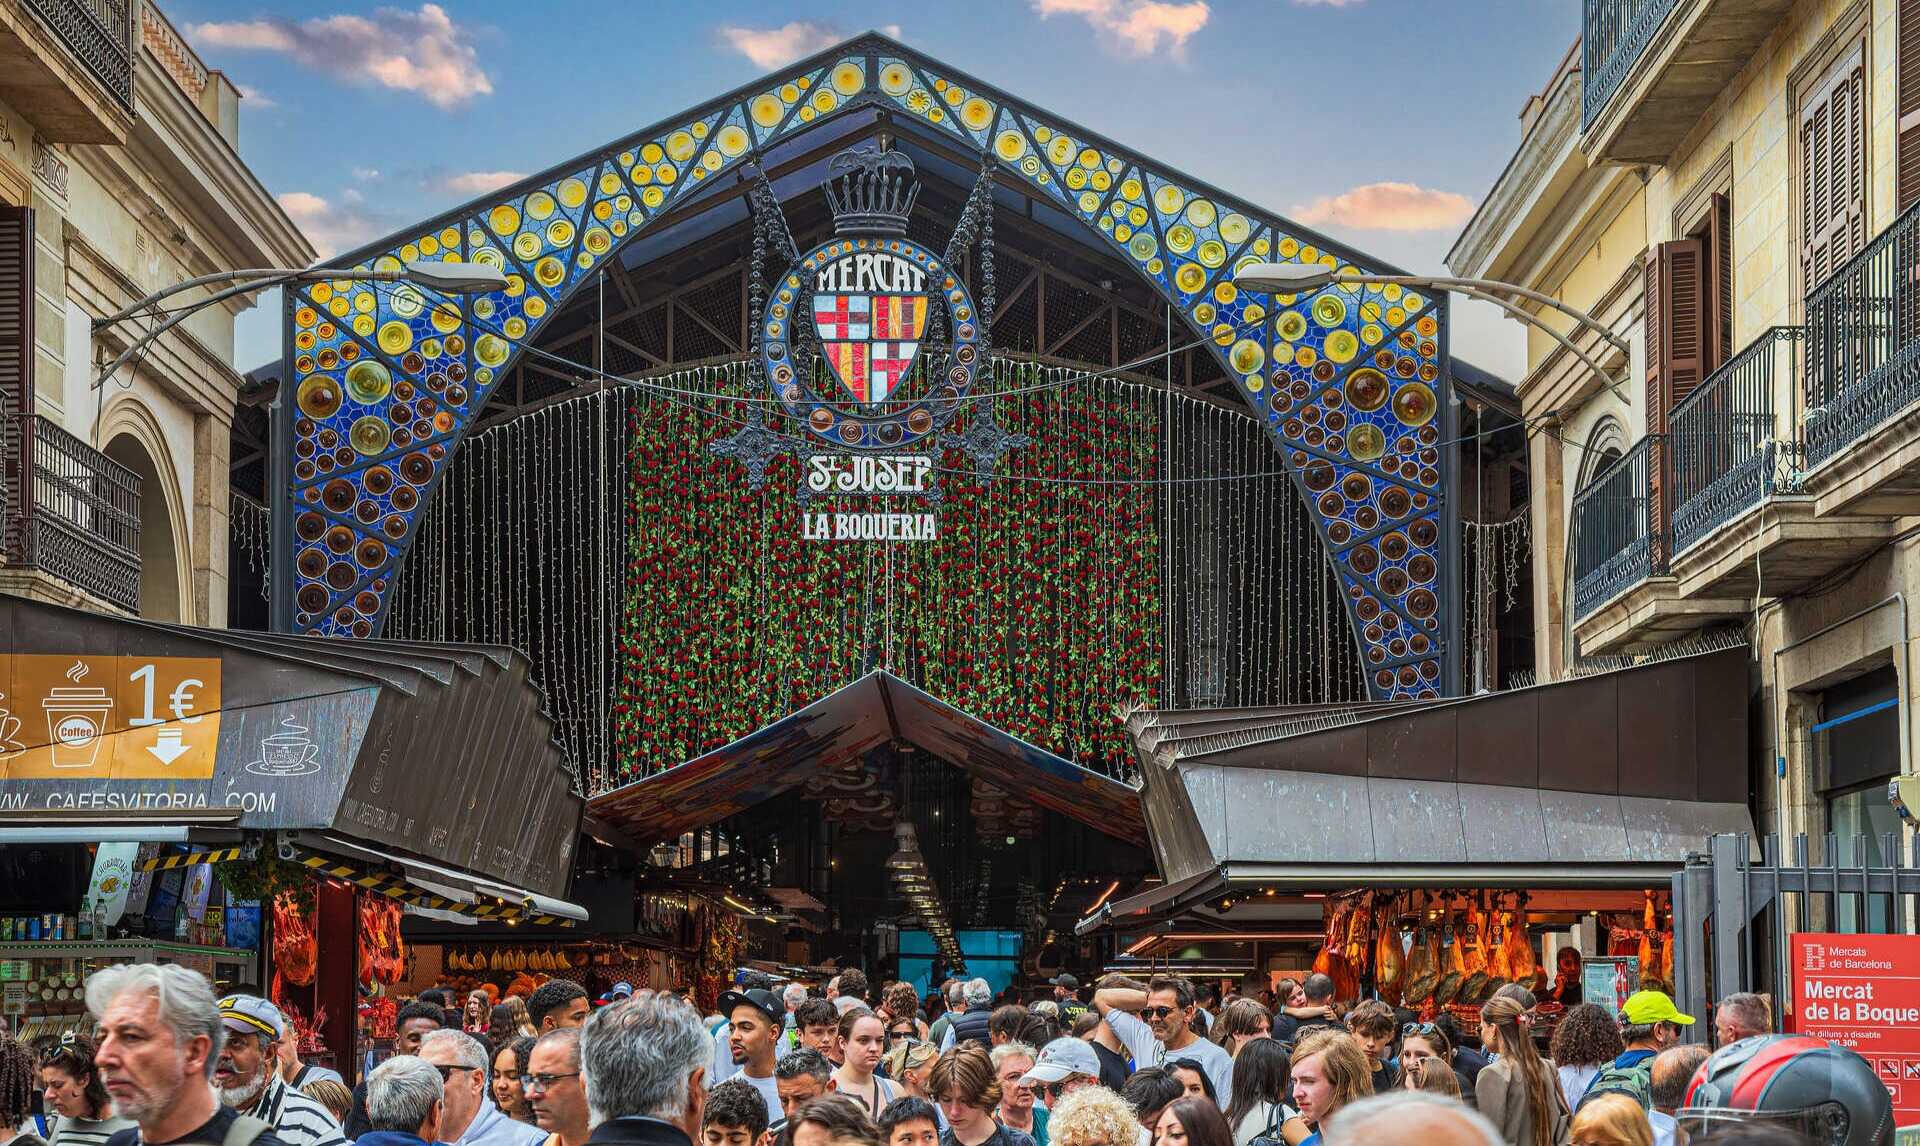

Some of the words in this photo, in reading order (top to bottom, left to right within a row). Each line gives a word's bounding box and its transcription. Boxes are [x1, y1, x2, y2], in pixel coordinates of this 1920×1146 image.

[818, 254, 926, 291] MERCAT
[830, 456, 932, 491] JOSEP
[803, 513, 832, 540] LA
[835, 513, 937, 540] BOQUERIA
[60, 726, 92, 738] Coffee
[1829, 947, 1866, 957] Mercats
[1829, 960, 1842, 969] de
[1845, 960, 1892, 969] Barcelona
[1805, 981, 1874, 1000] Mercat
[1805, 1002, 1829, 1021] de
[1833, 1002, 1850, 1021] la
[1855, 1003, 1919, 1026] Boque
[1817, 1030, 1842, 1038] dilluns
[1850, 1031, 1881, 1039] dissabte
